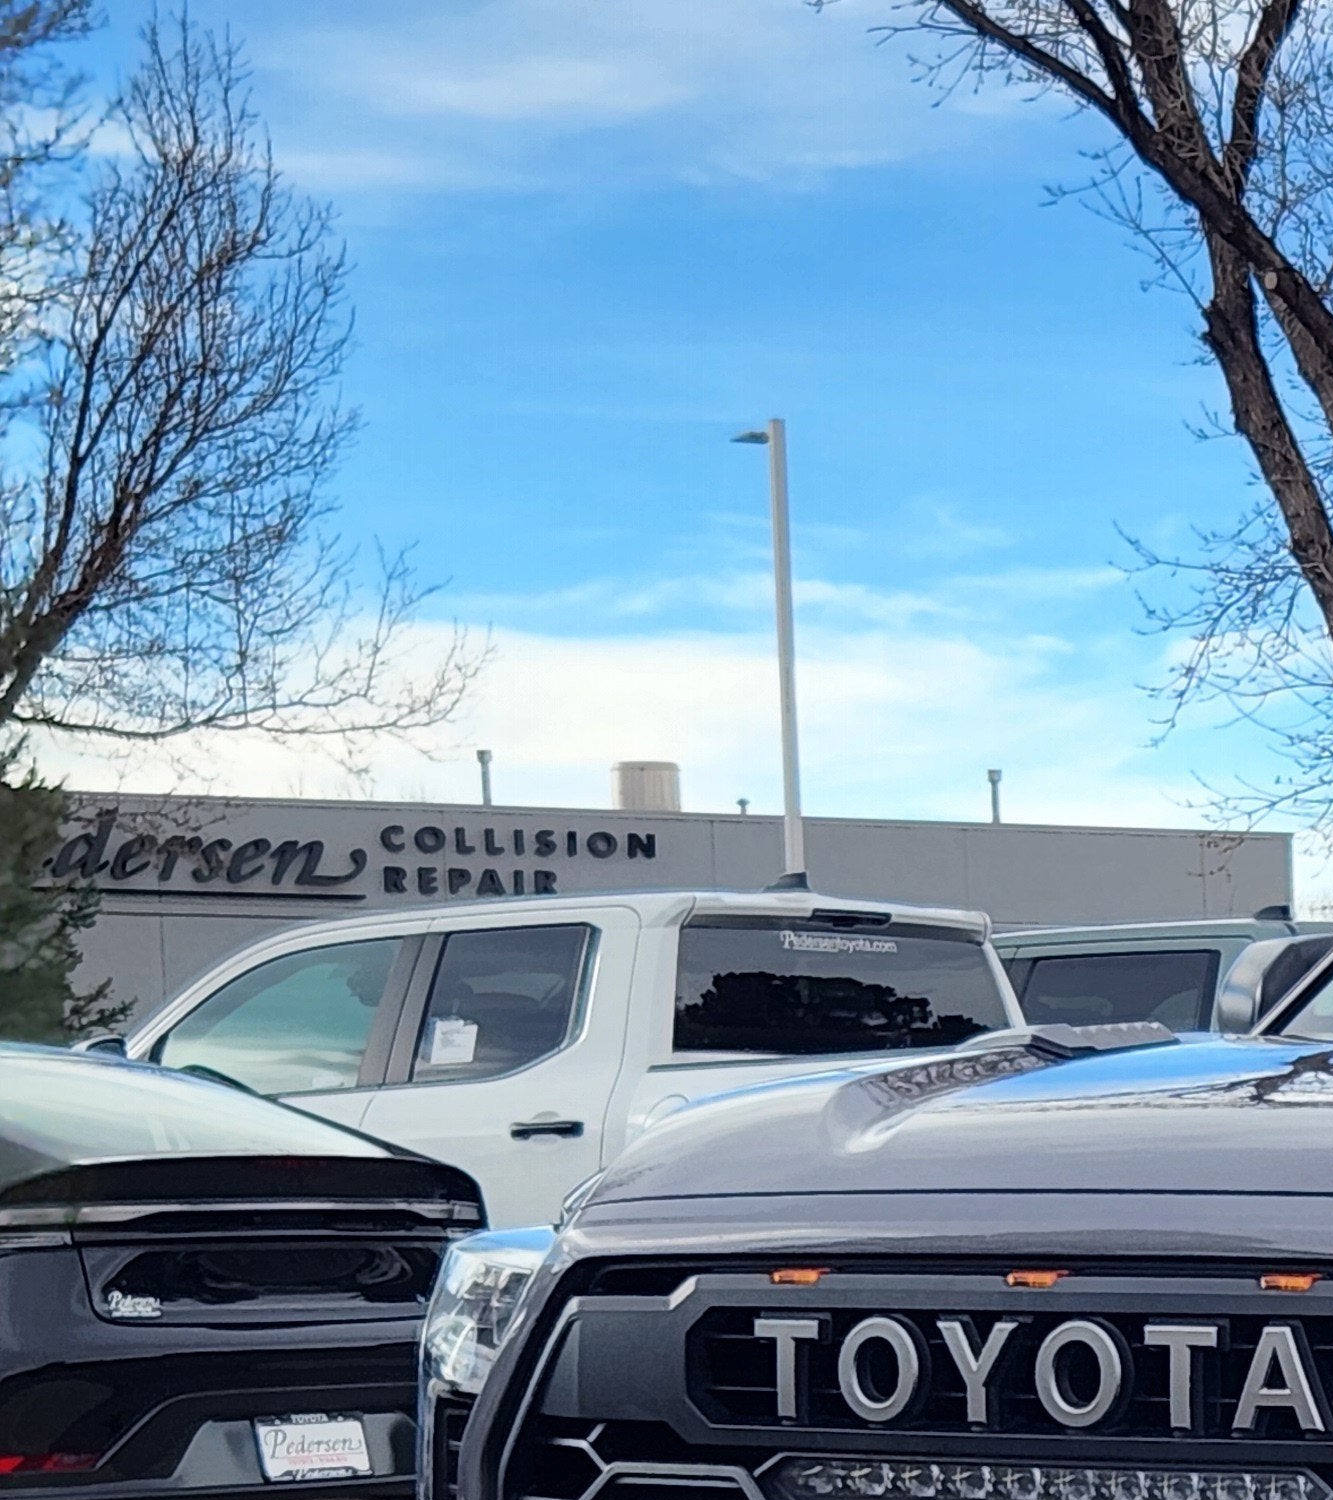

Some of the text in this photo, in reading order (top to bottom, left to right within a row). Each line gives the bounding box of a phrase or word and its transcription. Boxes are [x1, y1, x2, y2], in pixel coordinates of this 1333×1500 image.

[380, 825, 656, 859] COLLISION
[383, 866, 558, 895] REPAIR
[754, 1316, 1328, 1433] TOYOTA
[264, 1429, 363, 1460] Pedersen
